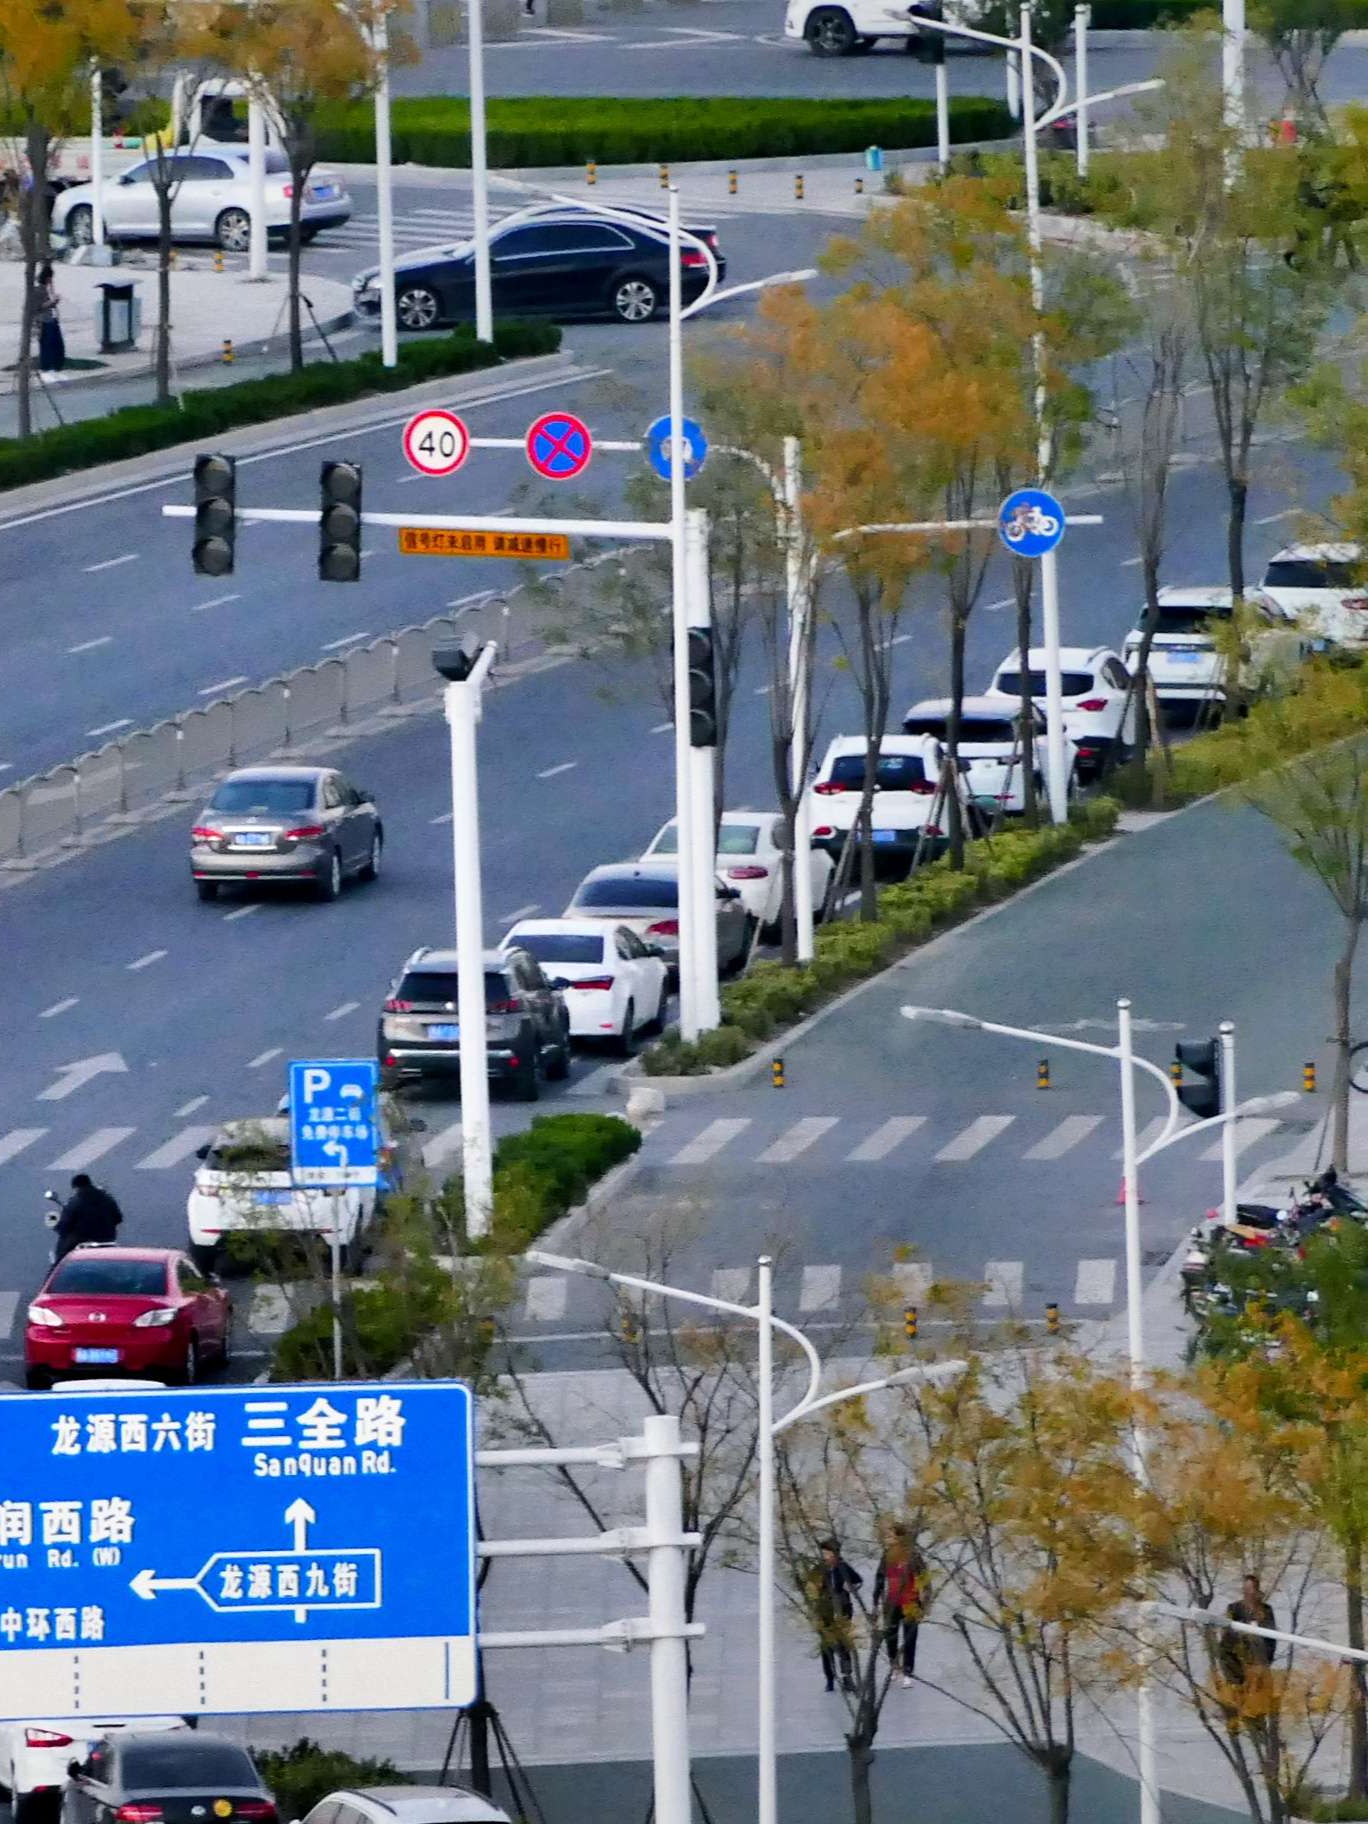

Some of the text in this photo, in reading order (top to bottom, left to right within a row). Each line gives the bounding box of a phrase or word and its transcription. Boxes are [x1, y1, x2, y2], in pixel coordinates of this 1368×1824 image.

[418, 430, 455, 458] 40
[303, 1068, 331, 1104] P
[51, 1411, 215, 1455] 龙源西六街
[241, 1395, 406, 1449] 三全路
[254, 1451, 397, 1477] Sanquan Rd.
[47, 1549, 80, 1568] Rd.
[92, 1547, 121, 1567] (W)
[219, 1563, 358, 1599] 龙源西九街
